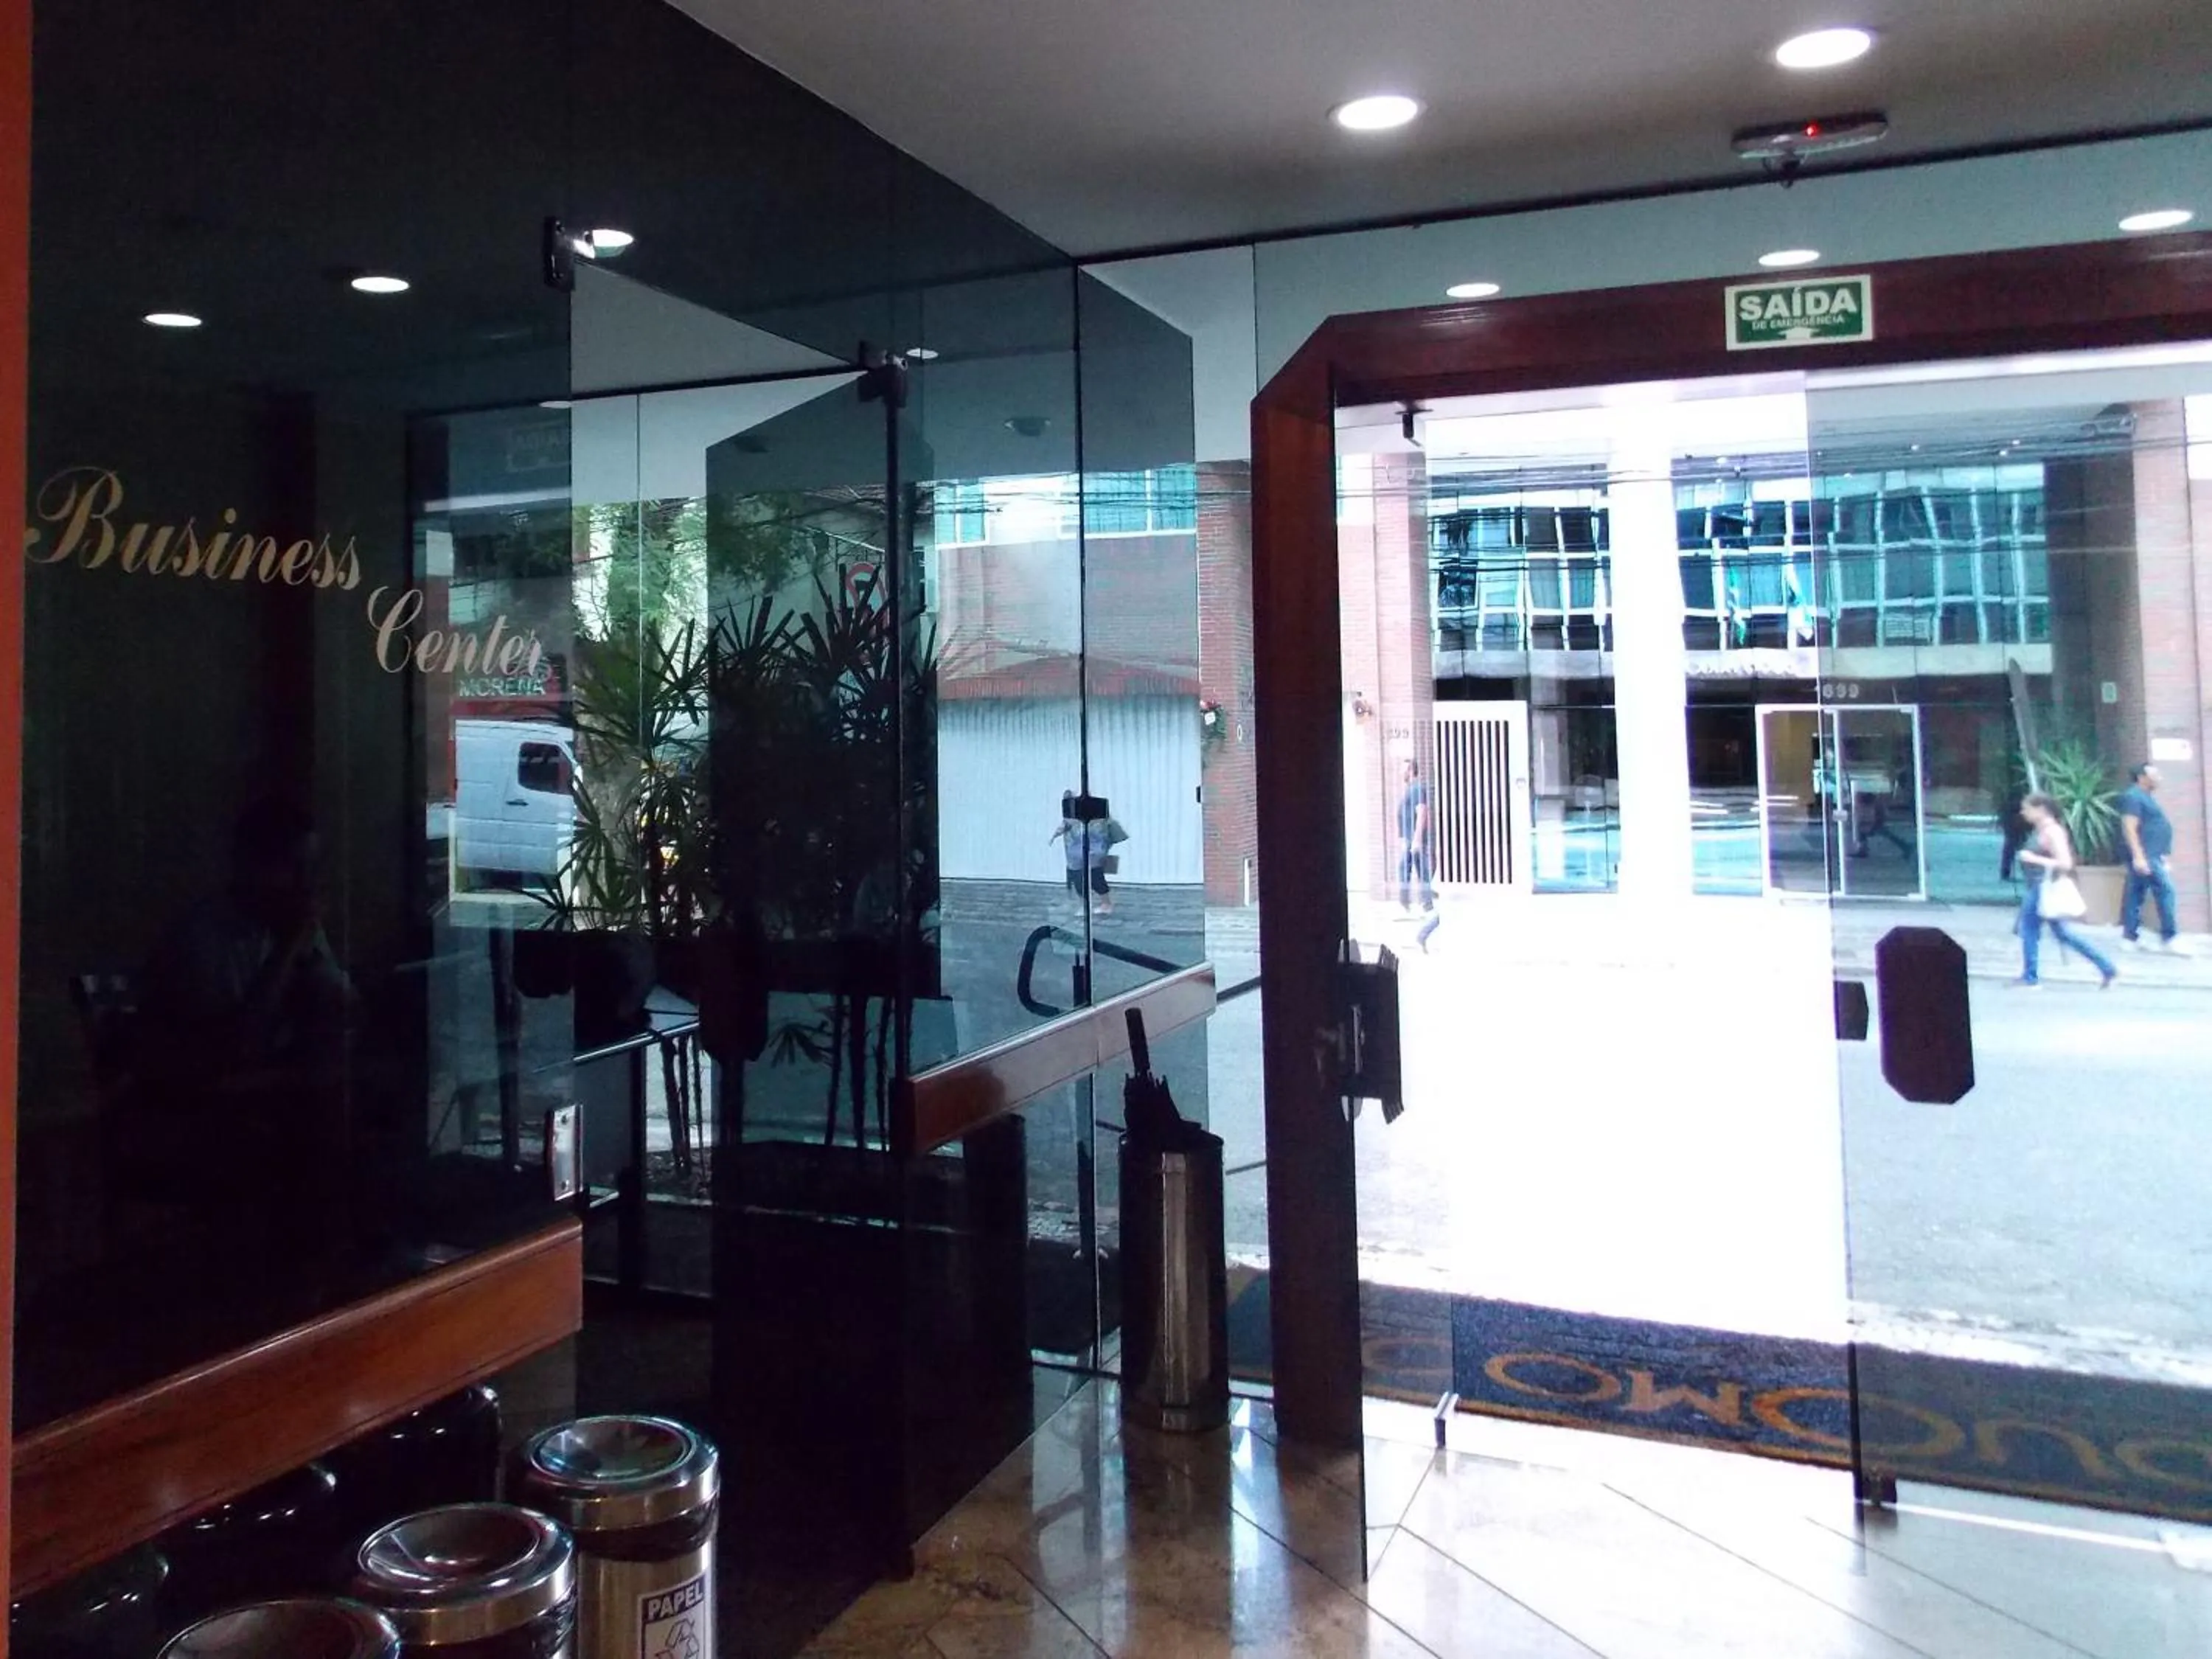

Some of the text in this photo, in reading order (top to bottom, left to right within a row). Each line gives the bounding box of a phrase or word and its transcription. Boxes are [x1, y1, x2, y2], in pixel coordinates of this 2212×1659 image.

[1739, 286, 1857, 321] SAÍDA
[24, 466, 543, 675] Business Center
[648, 1582, 703, 1620] PAPEL
